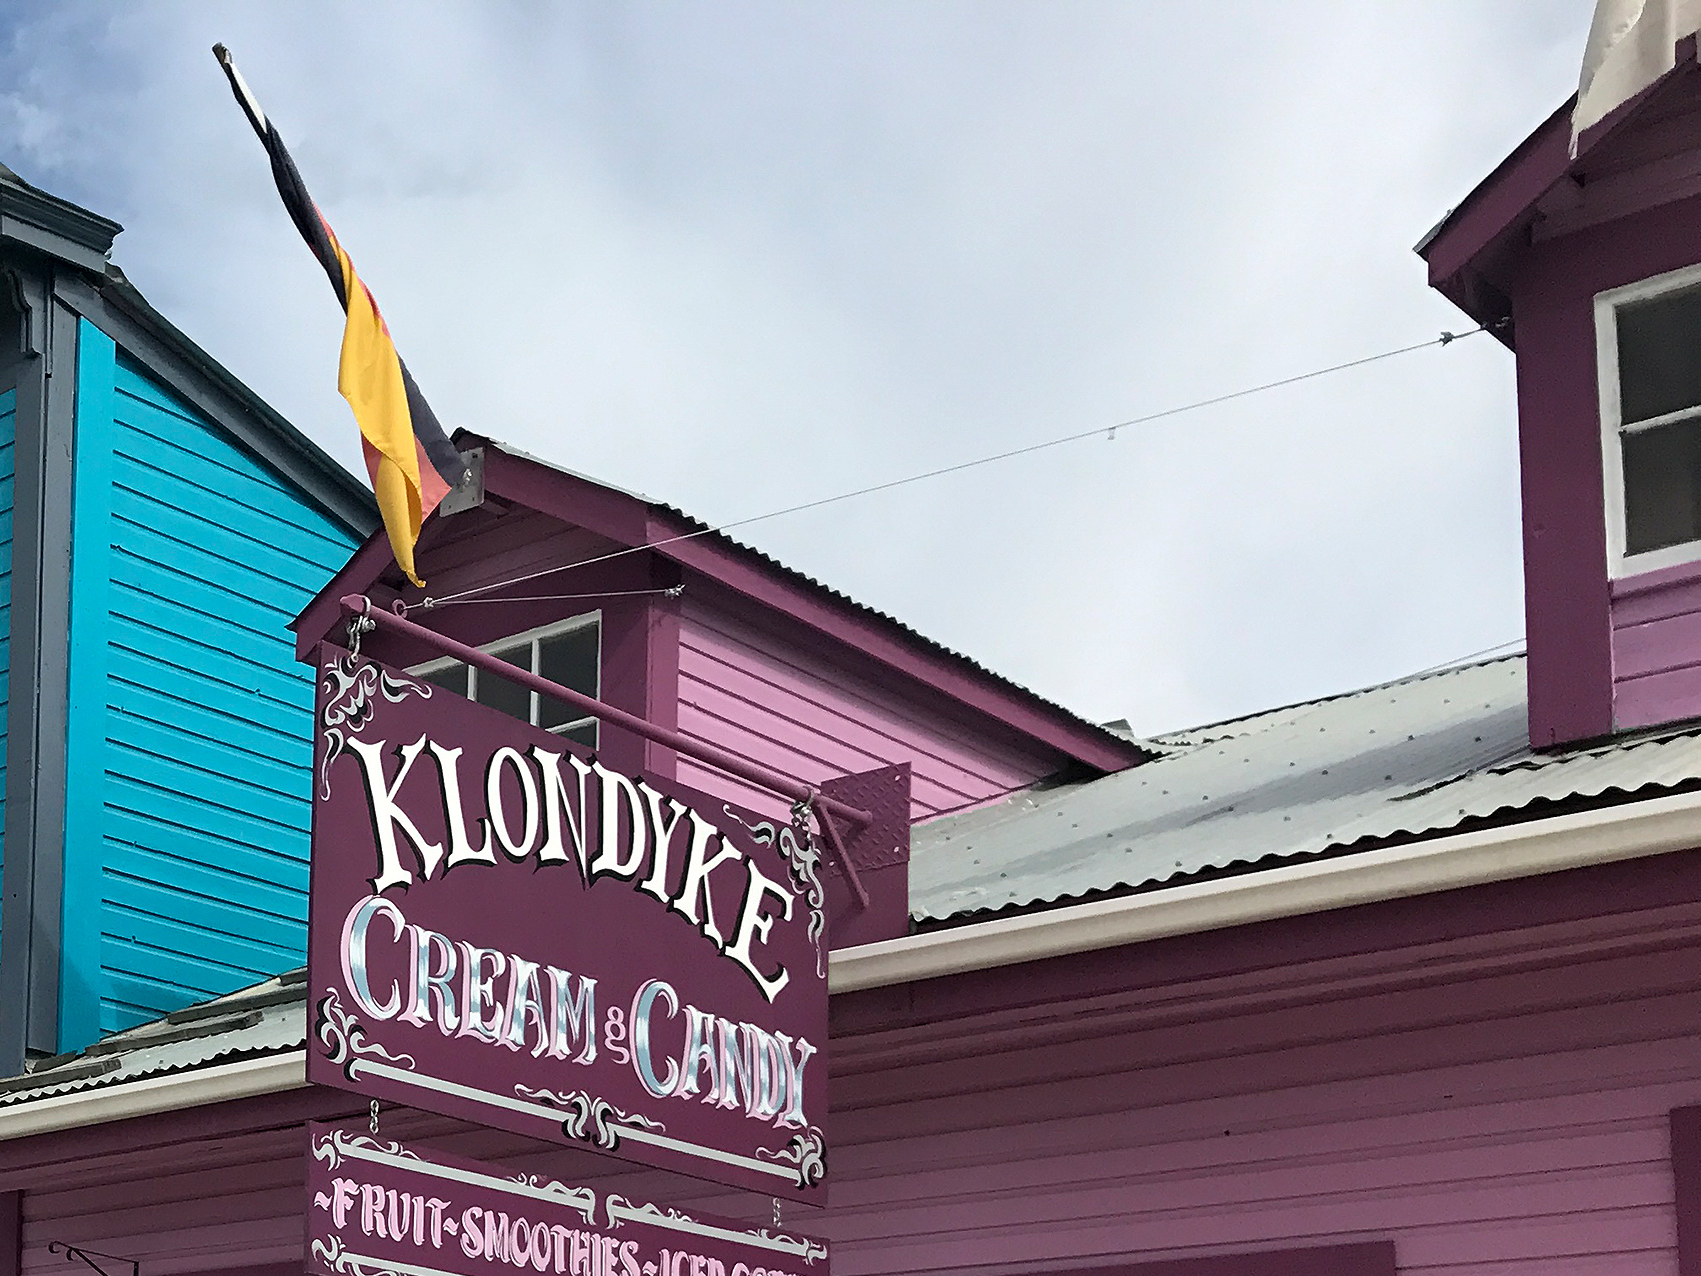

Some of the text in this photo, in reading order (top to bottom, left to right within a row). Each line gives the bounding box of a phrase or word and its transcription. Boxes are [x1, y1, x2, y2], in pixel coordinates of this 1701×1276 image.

[345, 733, 796, 1003] KLONDYKE
[340, 895, 598, 1066] CREAM
[631, 978, 817, 1128] CANDY
